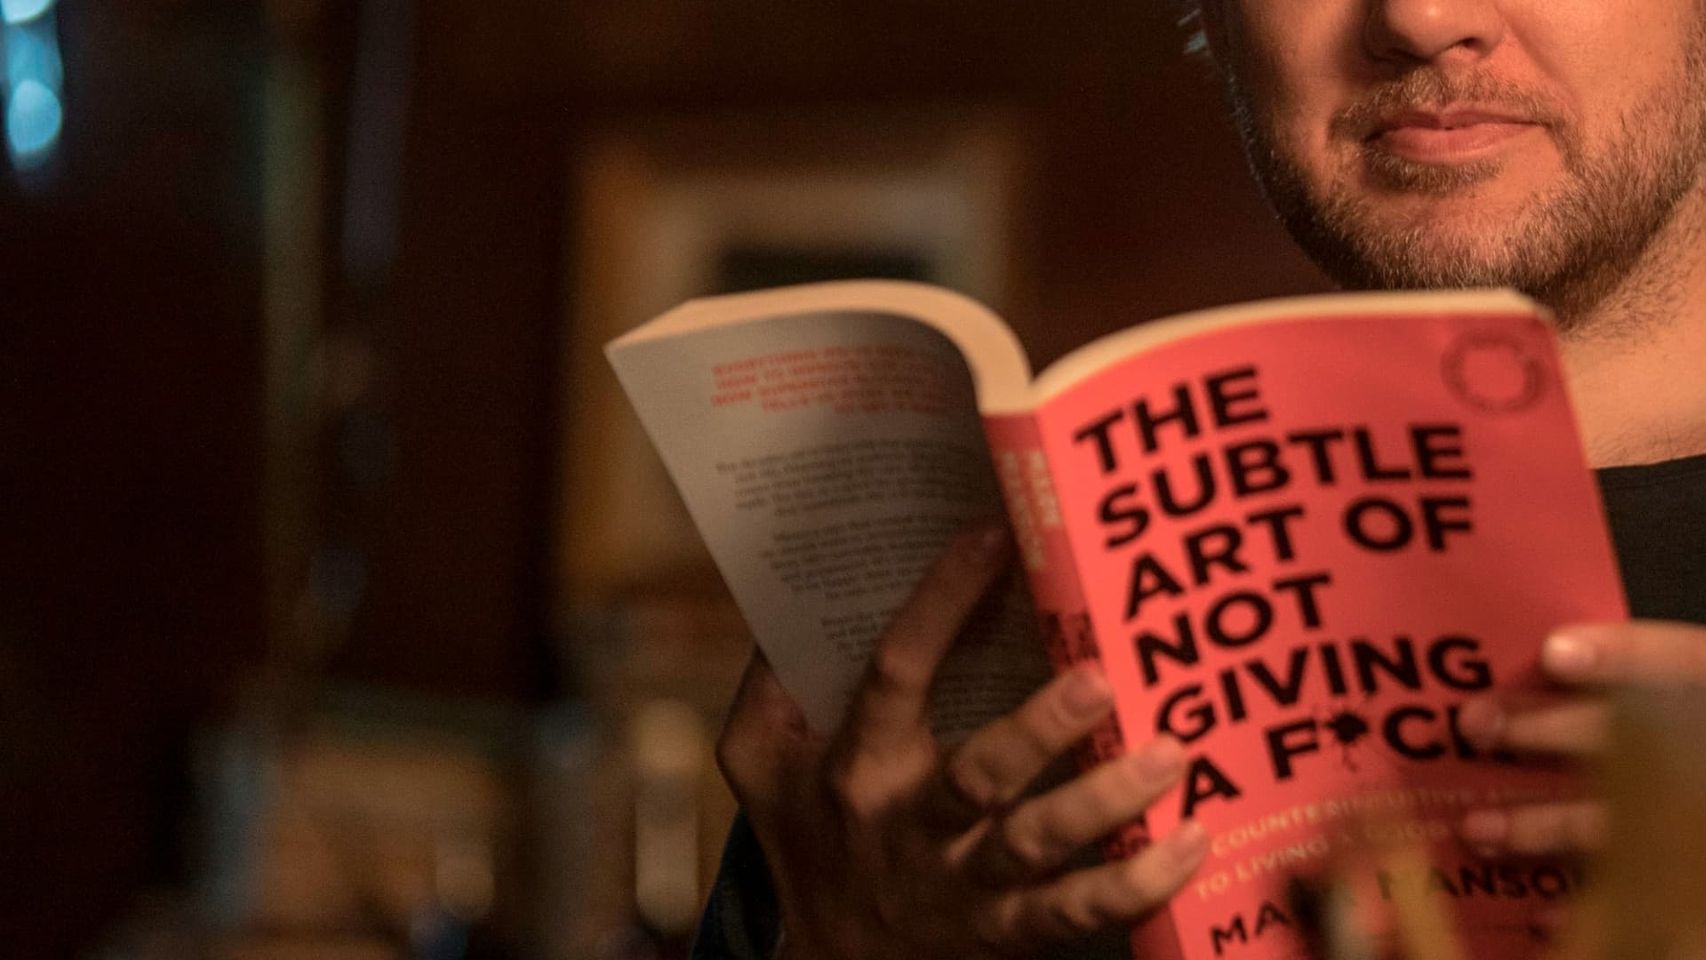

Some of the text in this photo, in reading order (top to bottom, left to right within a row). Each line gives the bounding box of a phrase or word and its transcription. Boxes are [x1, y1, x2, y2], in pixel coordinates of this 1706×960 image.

[1075, 366, 1270, 473] THE
[1097, 424, 1474, 550] SUBTLE
[1125, 504, 1306, 620] ART
[1342, 495, 1473, 553] OF
[1134, 571, 1332, 687] NOT
[1155, 634, 1495, 745] GIVING
[1180, 754, 1242, 821] A
[1194, 870, 1230, 903] TO
[1234, 836, 1331, 883] LIVING
